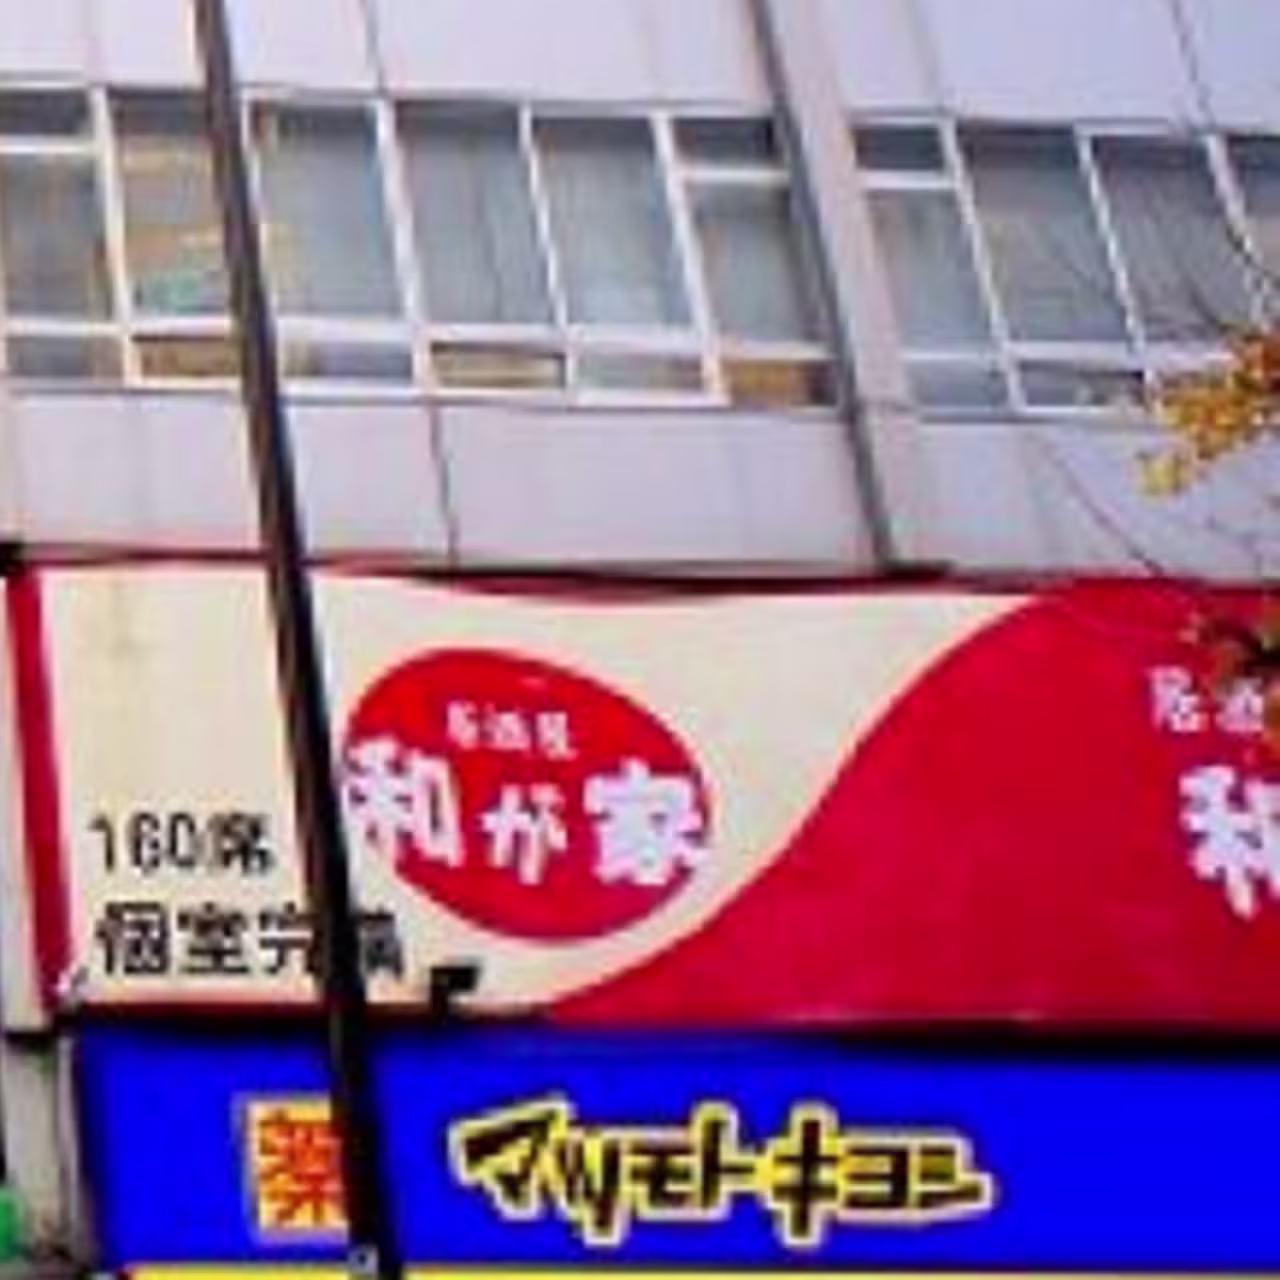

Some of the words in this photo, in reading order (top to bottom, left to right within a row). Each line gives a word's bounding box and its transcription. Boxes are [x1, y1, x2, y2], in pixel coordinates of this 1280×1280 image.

[88, 811, 276, 873] 160席
[340, 738, 708, 886] 和が家
[448, 1102, 994, 1246] マツモトキヨシ
